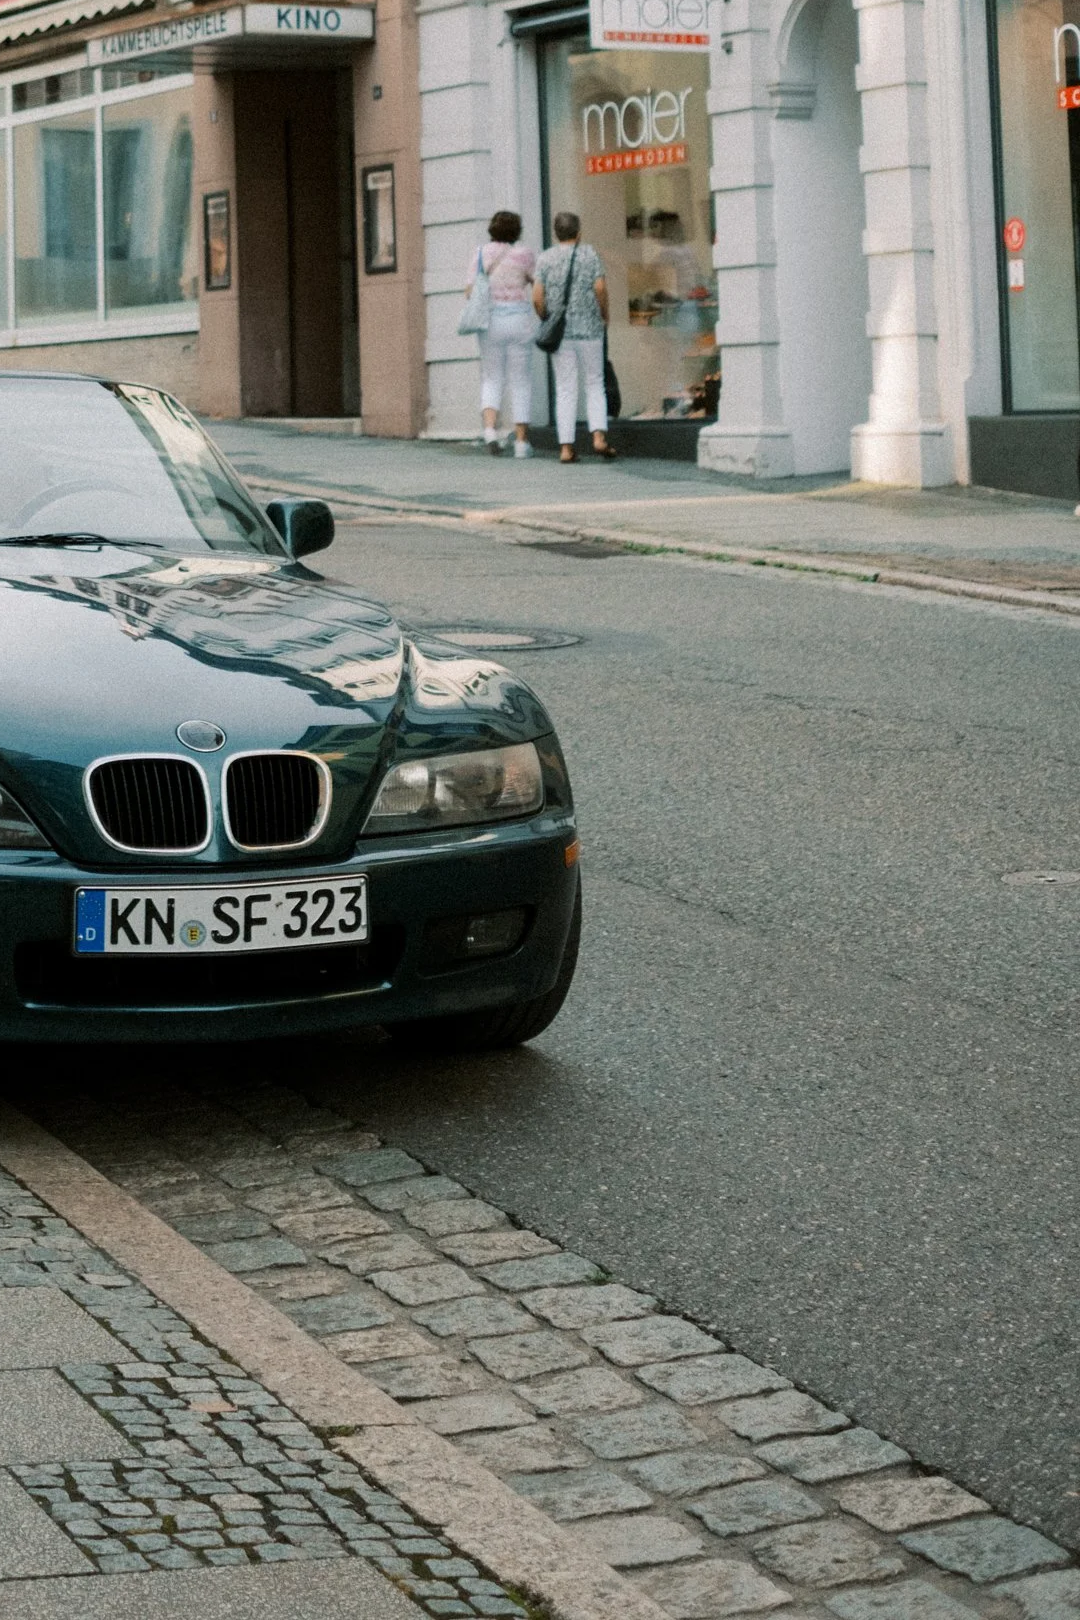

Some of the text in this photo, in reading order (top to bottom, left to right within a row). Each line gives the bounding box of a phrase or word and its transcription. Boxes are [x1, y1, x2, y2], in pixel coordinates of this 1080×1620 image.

[100, 11, 228, 58] KAMMERLICHTSPIELE
[276, 8, 341, 31] KINO
[583, 86, 693, 154] maier
[588, 146, 686, 173] SCHUHMODEN
[110, 885, 363, 946] KN SF 323
[85, 927, 97, 942] D
